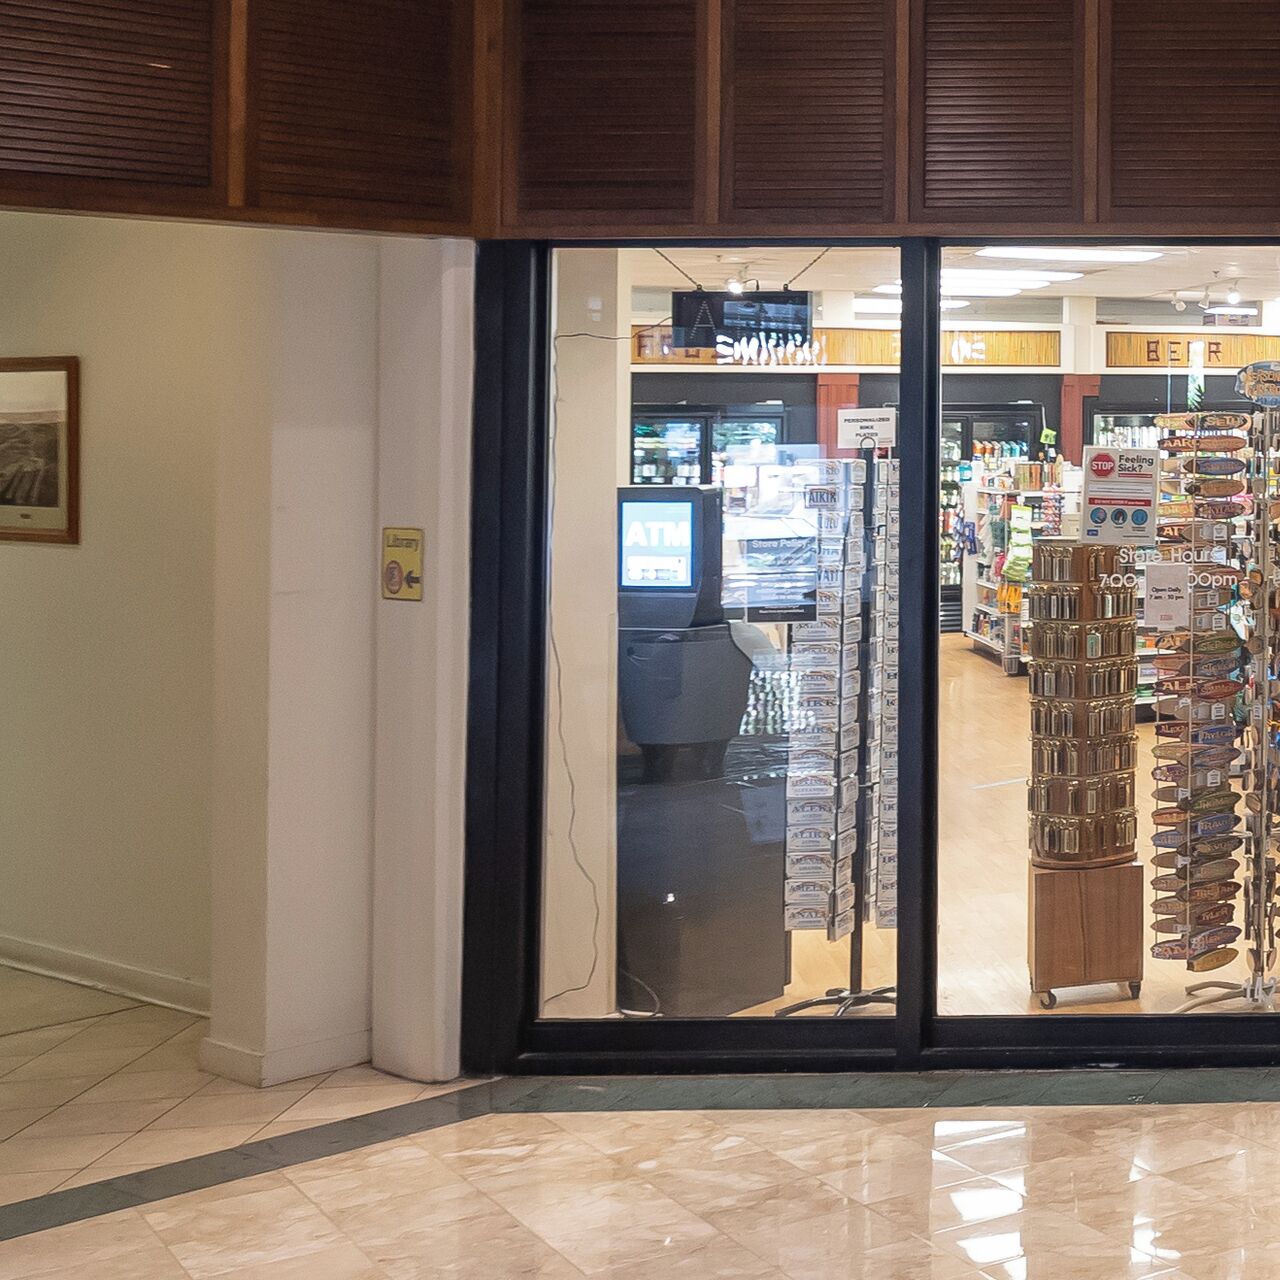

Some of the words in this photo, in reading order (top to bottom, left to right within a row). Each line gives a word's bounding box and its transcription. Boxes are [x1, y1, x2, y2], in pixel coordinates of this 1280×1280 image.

[1147, 339, 1222, 362] BER
[1092, 461, 1114, 470] STOP
[1118, 454, 1154, 466] Feeling
[1118, 464, 1143, 472] Sick?
[626, 521, 690, 547] ATM
[1119, 548, 1163, 563] Store
